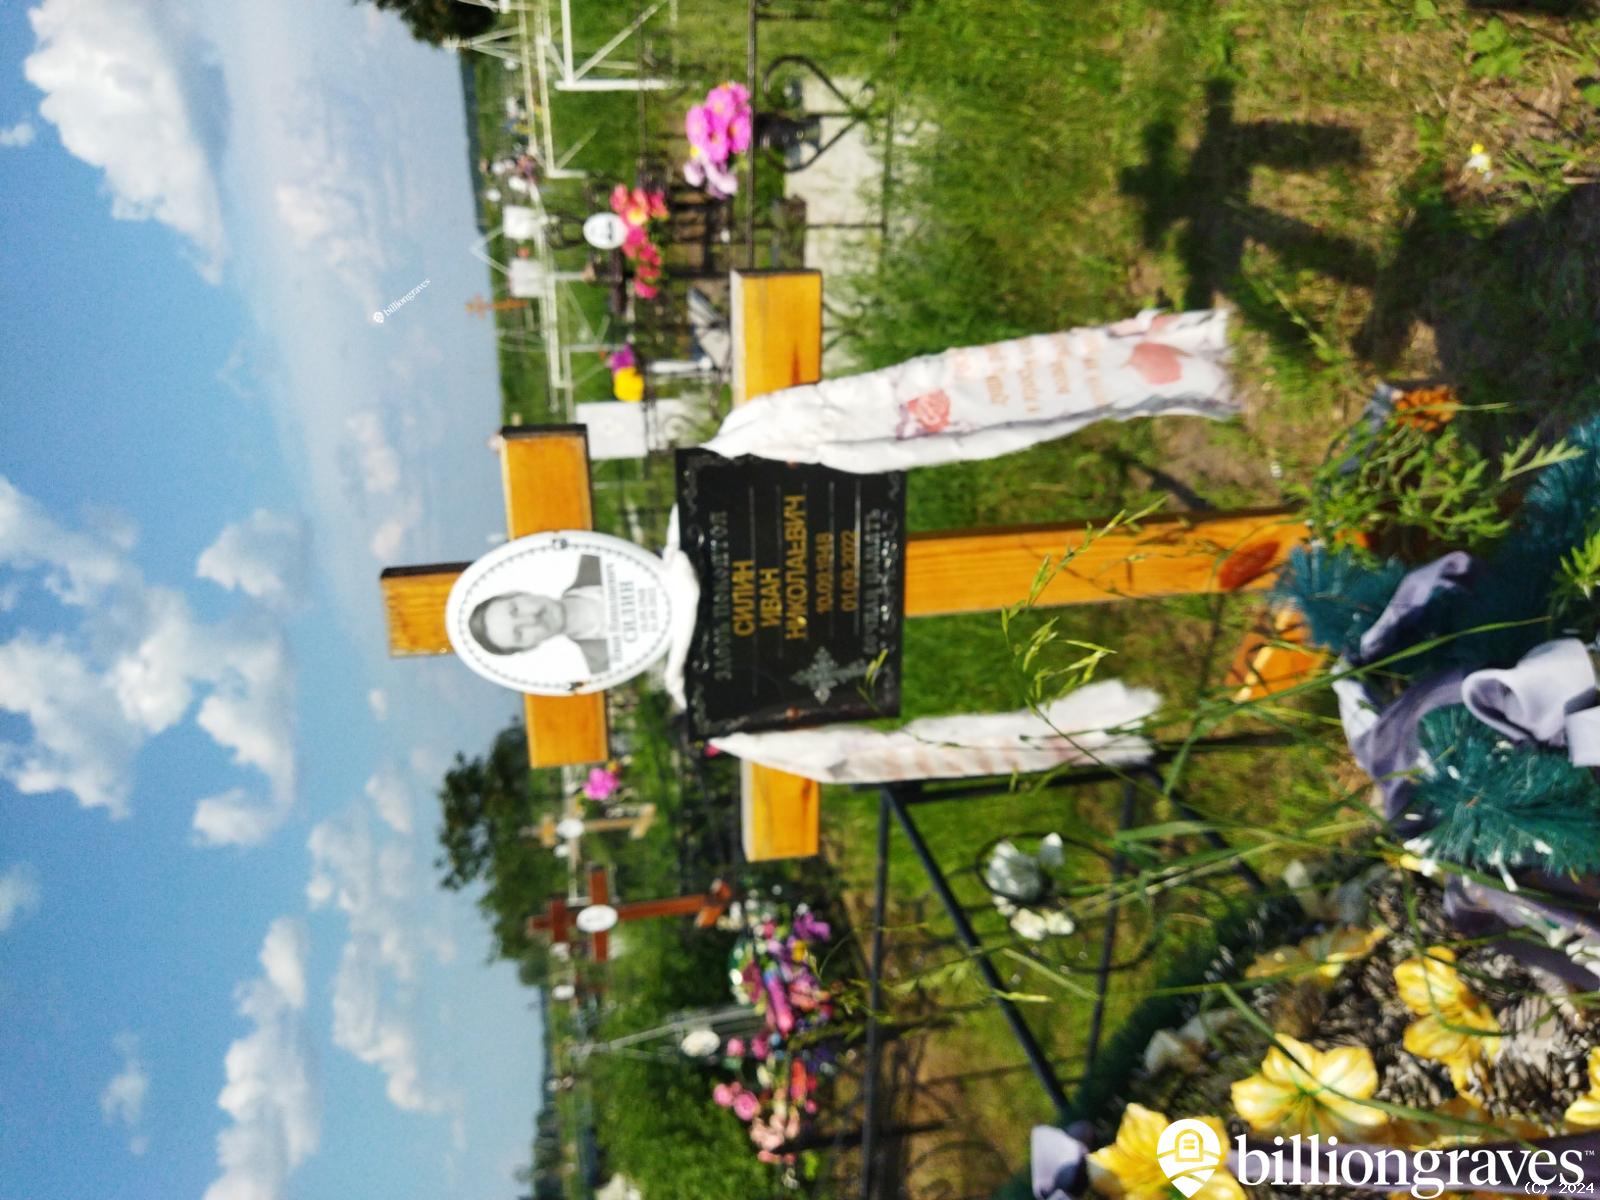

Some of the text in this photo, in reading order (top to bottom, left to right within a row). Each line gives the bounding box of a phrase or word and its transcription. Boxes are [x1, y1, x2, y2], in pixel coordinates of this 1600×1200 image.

[731, 560, 756, 637] СИЛИН
[759, 568, 782, 628] ИВАН
[783, 494, 808, 640] НИКОЛАЕВИЧ
